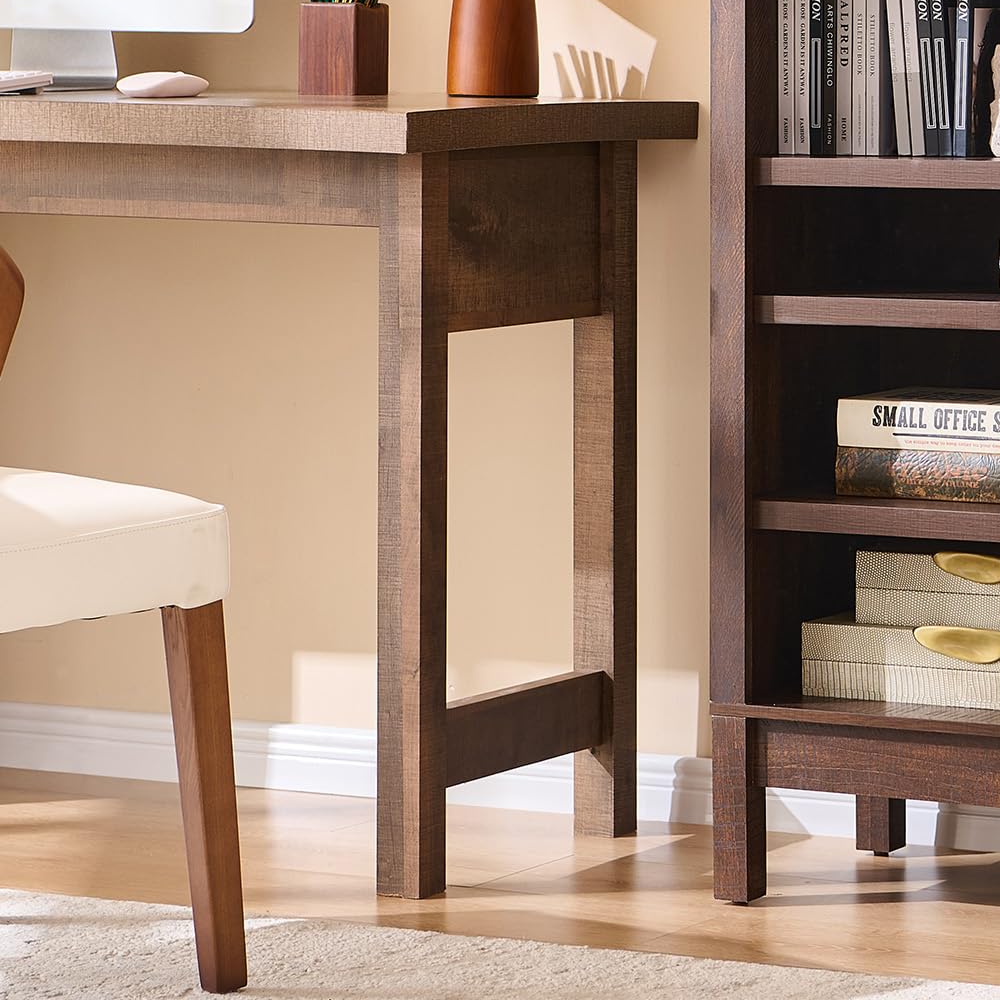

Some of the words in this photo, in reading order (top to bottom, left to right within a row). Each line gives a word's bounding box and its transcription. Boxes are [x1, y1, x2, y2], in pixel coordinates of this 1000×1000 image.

[826, 4, 834, 29] ARTS
[840, 0, 849, 67] ALPRED
[826, 32, 834, 87] CHIWINGLO
[872, 404, 927, 429] SMALL
[933, 408, 987, 432] OFFICE
